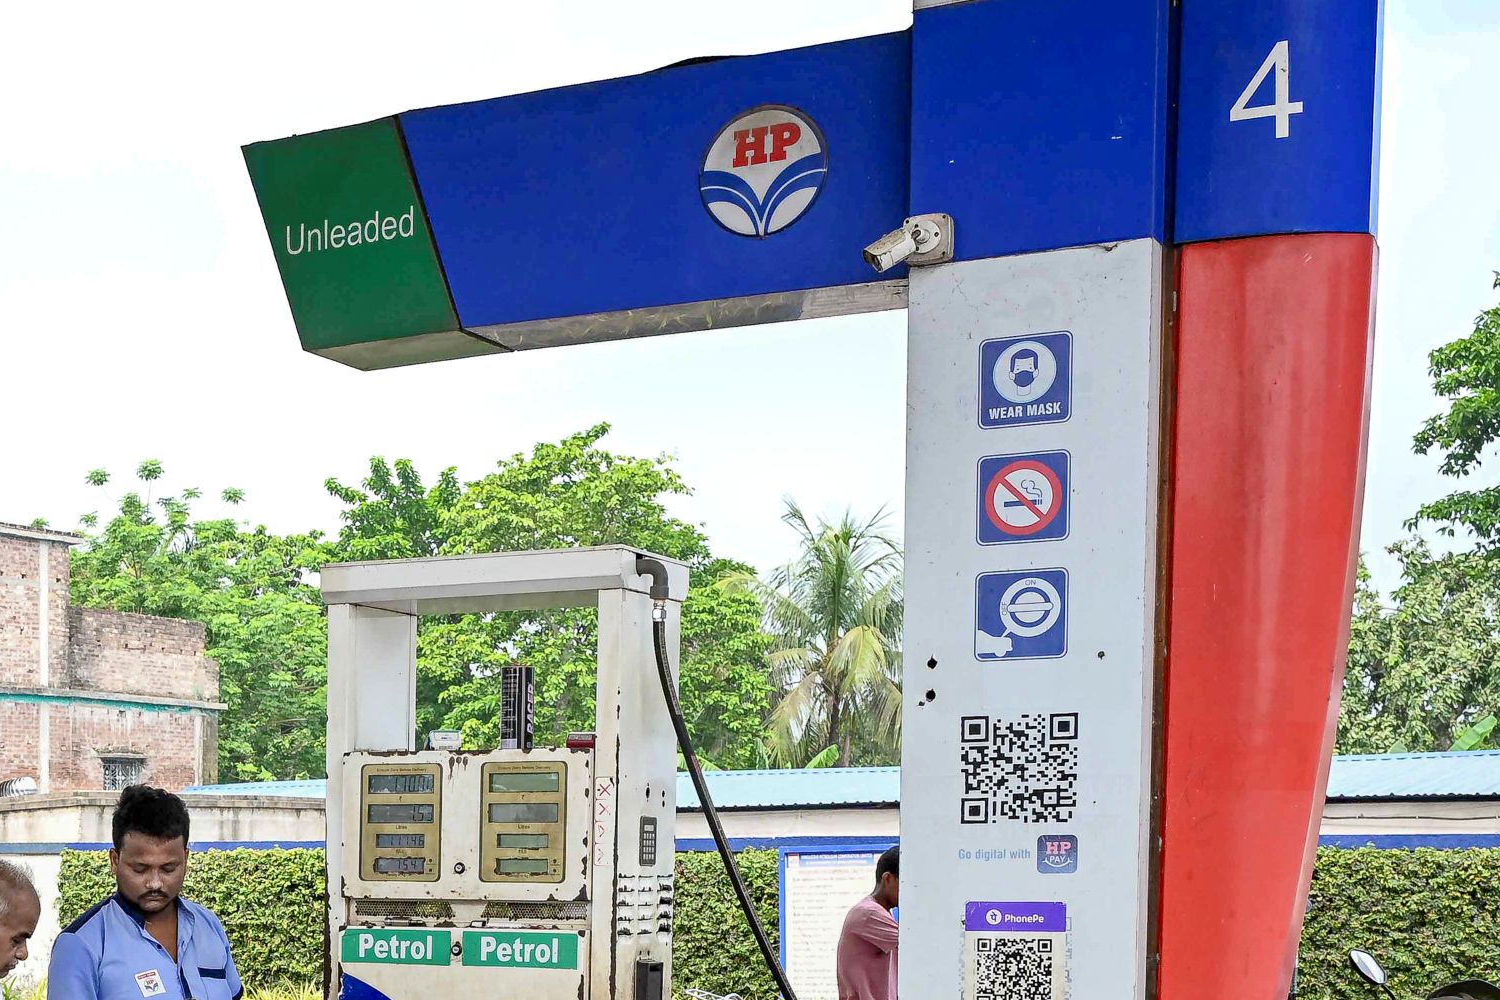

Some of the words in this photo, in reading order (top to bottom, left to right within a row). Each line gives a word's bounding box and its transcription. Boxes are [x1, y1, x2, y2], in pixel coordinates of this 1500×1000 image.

[1229, 41, 1303, 138] 4
[732, 121, 802, 168] HP
[285, 205, 415, 255] Unleaded
[989, 405, 1023, 420] WEAR
[1027, 401, 1061, 417] MASK
[958, 849, 972, 860] Go
[975, 849, 1006, 861] digital
[1009, 849, 1031, 859] with
[1045, 841, 1071, 855] HP
[1049, 855, 1066, 863] PAY
[1004, 913, 1045, 923] PhonePe
[358, 933, 433, 960] Petrol
[480, 936, 559, 963] Petrol
